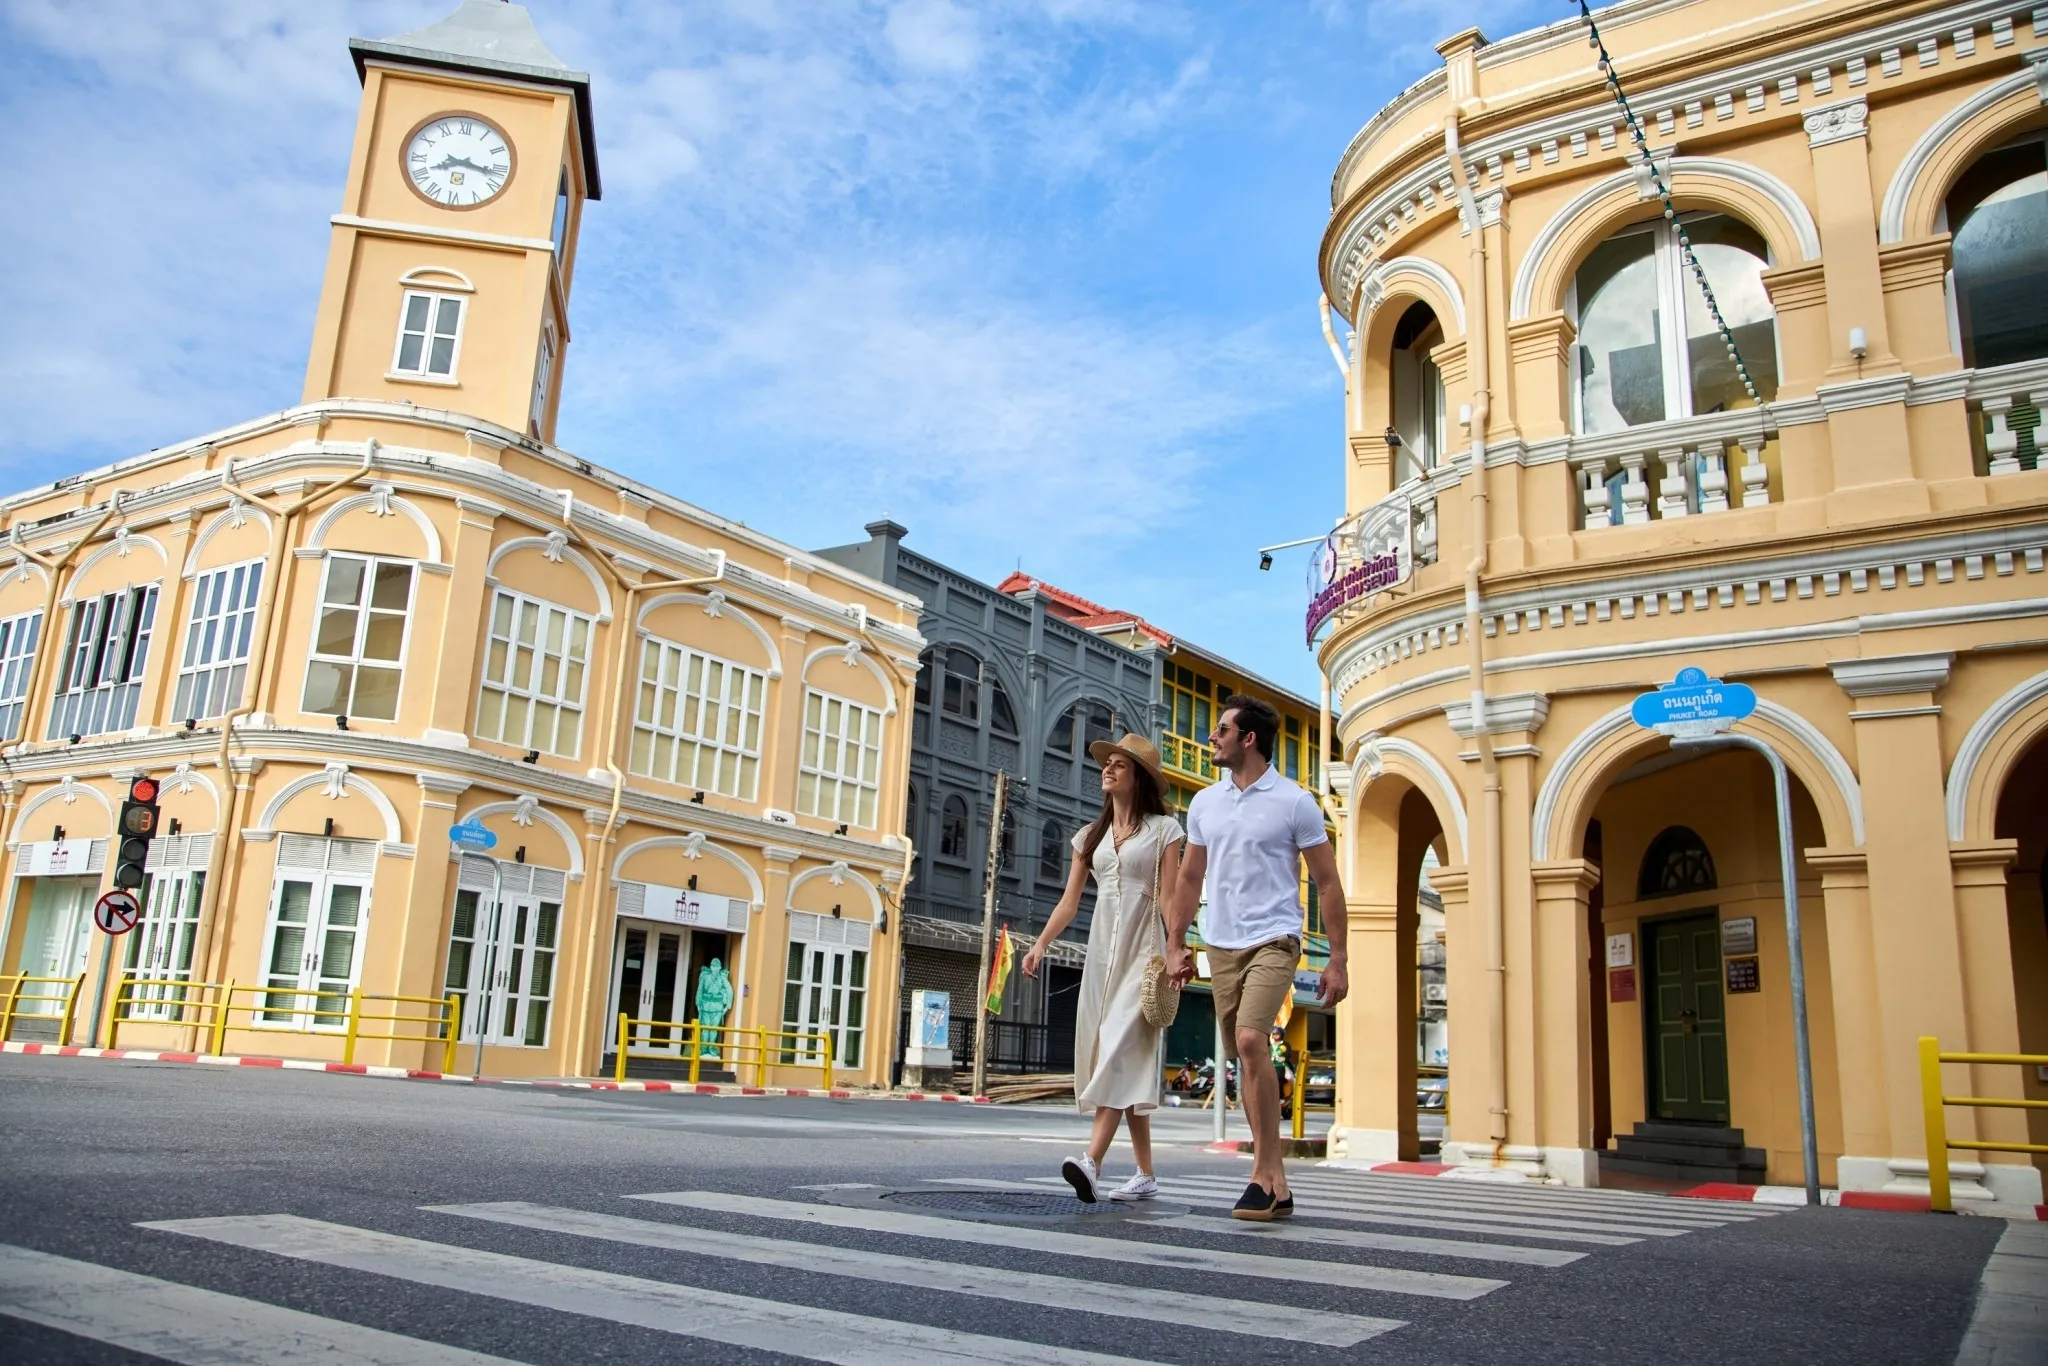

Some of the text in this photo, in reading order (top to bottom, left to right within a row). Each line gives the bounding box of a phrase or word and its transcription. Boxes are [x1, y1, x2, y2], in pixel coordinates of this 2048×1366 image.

[437, 123, 452, 137] XI
[458, 121, 472, 135] XII
[420, 134, 435, 147] X
[480, 130, 490, 141] I
[490, 145, 505, 155] II
[412, 152, 427, 163] IX
[413, 167, 430, 184] VIII
[424, 181, 442, 198] VII
[486, 177, 501, 194] IV
[447, 190, 460, 205] VI
[1346, 567, 1399, 600] MUSEUM
[1664, 689, 1722, 711] ถนนภูเก็ต
[1668, 709, 1718, 720] PHUKET ROAD
[140, 810, 152, 831] 3
